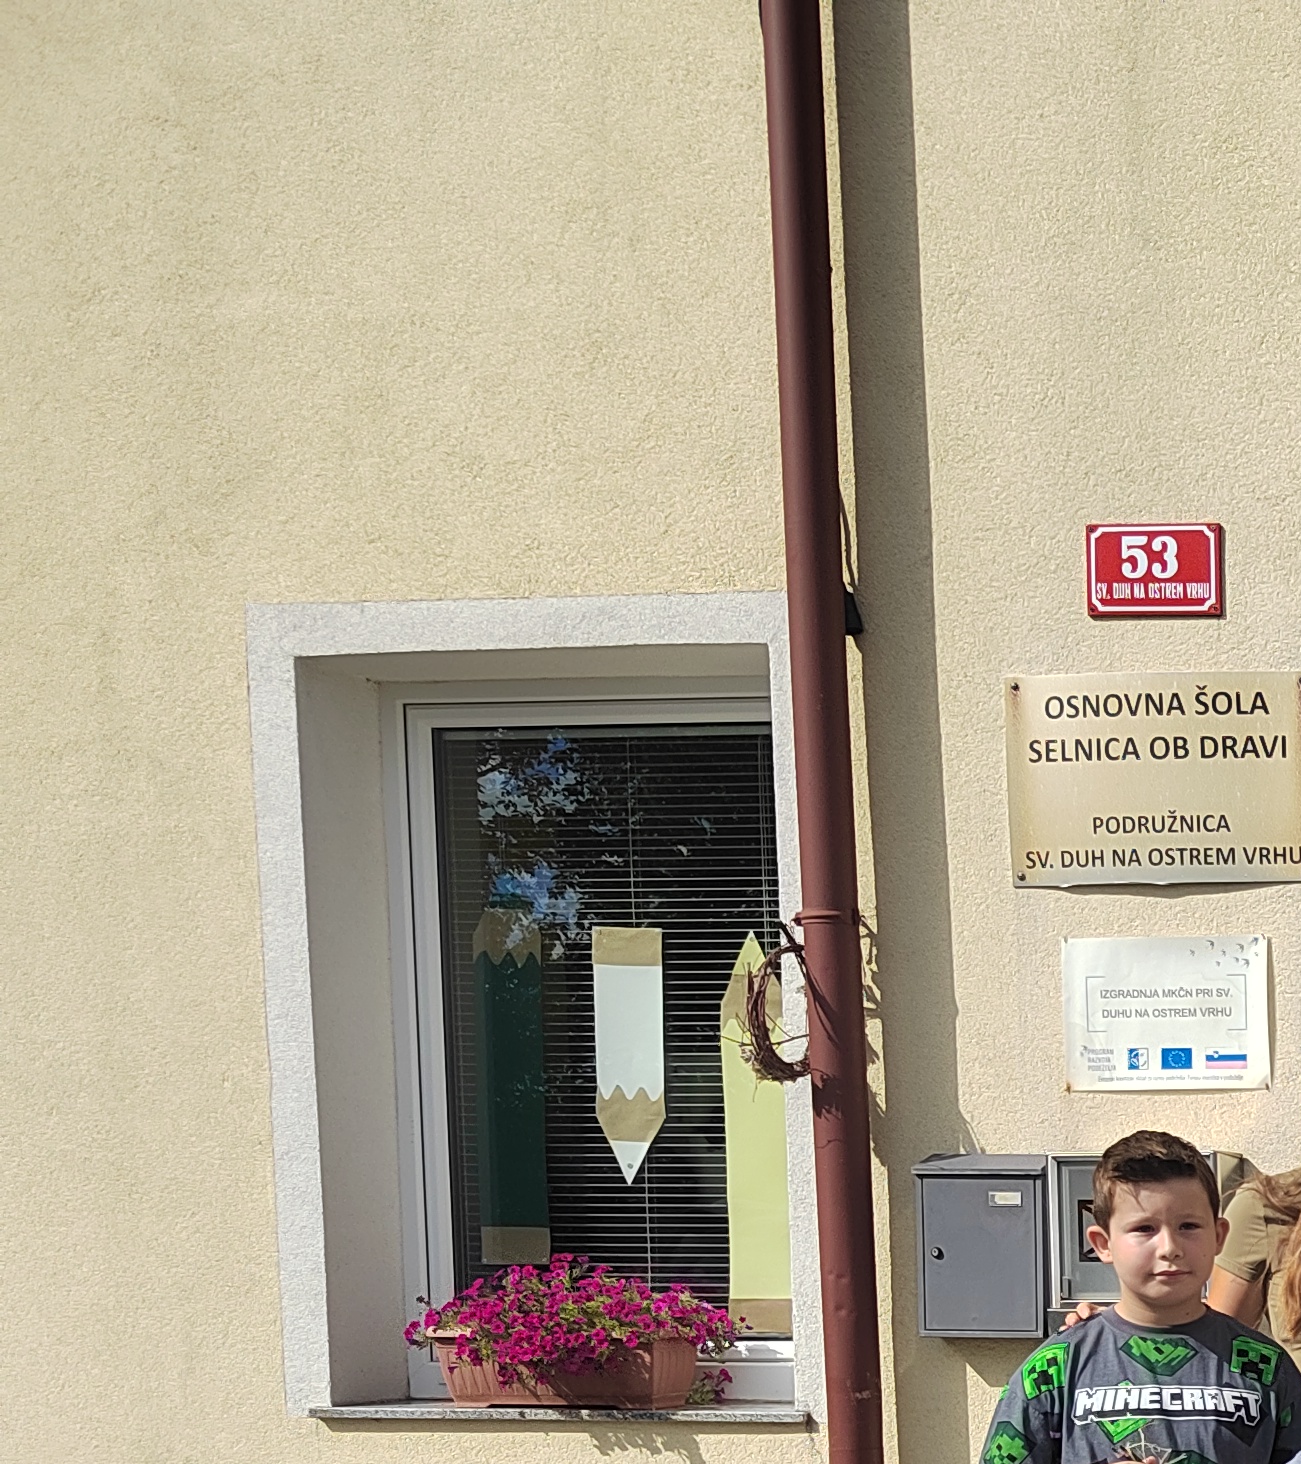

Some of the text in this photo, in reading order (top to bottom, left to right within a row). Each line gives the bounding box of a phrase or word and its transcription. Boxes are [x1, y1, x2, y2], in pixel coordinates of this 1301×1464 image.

[1121, 535, 1179, 579] 53
[1096, 582, 1210, 600] SV. DUH NA OSTREM VRHU
[1044, 685, 1270, 720] OSNOVNA ŠOLA
[1028, 735, 1288, 764] SELNICA OB DRAVI
[1092, 810, 1231, 835] PODRUŽNICA
[1025, 850, 1054, 870] SV.
[1060, 849, 1105, 869] DUH
[1112, 849, 1142, 867] NA
[1147, 846, 1236, 867] OSTREM
[1100, 986, 1233, 999] IZGRADNJA MKČN PRI SV.
[1102, 1006, 1232, 1019] DUHU NA OSTREM VRHU
[1073, 1386, 1262, 1422] MINECRAFT
